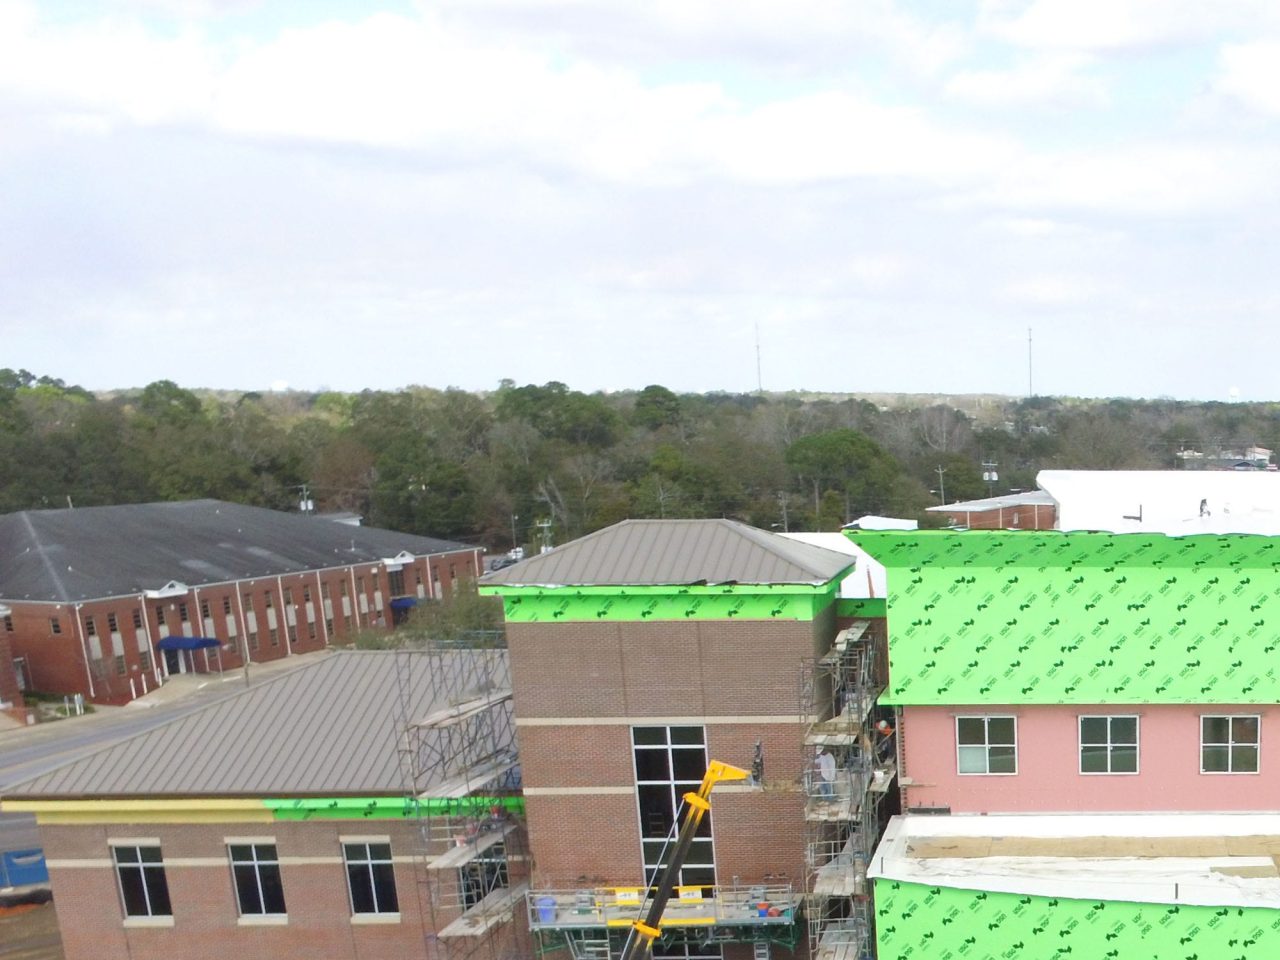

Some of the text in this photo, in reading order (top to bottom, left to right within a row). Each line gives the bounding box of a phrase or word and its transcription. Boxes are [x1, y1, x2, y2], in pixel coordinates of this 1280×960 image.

[1159, 914, 1171, 924] USG
[1207, 916, 1219, 926] USG
[1189, 926, 1200, 937] USG
[1252, 929, 1264, 939] USG
